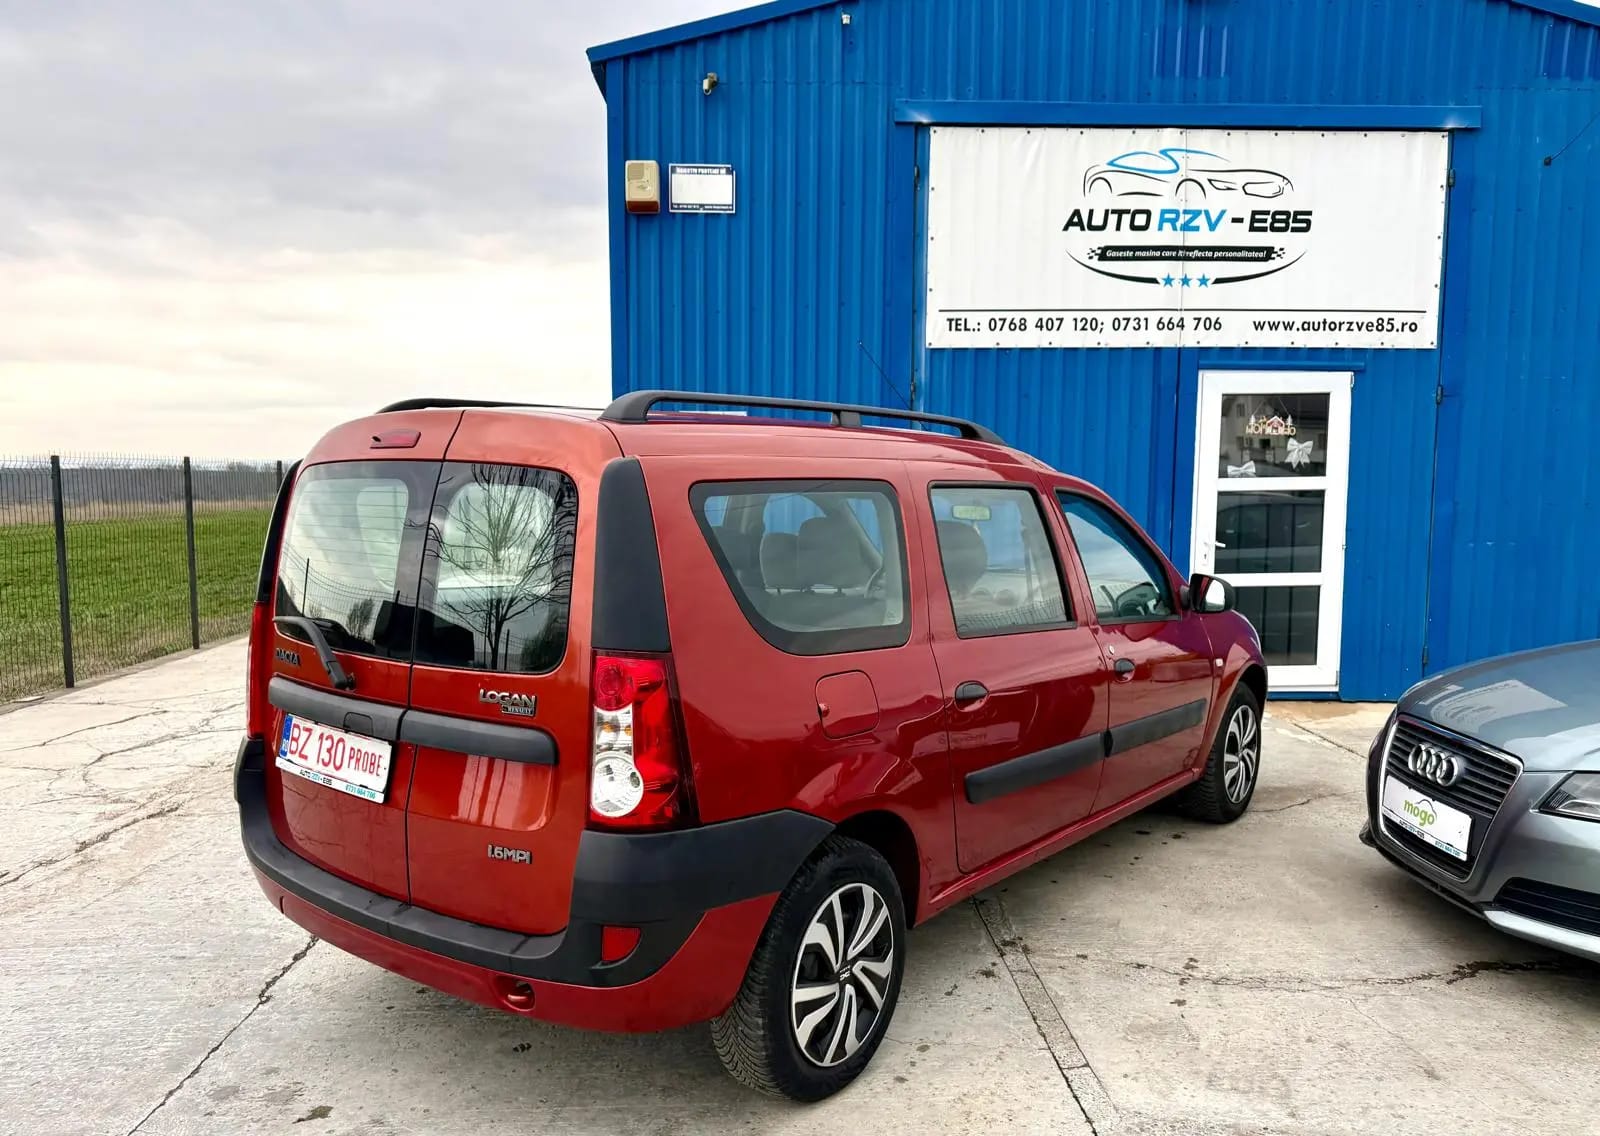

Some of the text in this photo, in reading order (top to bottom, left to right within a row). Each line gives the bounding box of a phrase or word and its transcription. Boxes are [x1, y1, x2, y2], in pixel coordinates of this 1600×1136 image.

[1062, 208, 1152, 232] AUTO
[1157, 208, 1227, 232] RZV
[1248, 209, 1312, 233] E85
[1106, 249, 1134, 258] Gaseste
[1134, 249, 1160, 258] masina
[1161, 250, 1177, 258] care
[1186, 249, 1213, 259] reflecta
[1213, 250, 1267, 259] personalitatea!
[946, 316, 1223, 334] TEL.: 0768 407 120; 0731 664 706
[1252, 317, 1419, 333] www.autorzve85.ro
[275, 648, 299, 667] DACIA
[480, 688, 536, 708] LOGAN
[289, 723, 384, 777] BZ 130 PROBE
[1403, 800, 1435, 827] mogo
[487, 845, 532, 864] 1.6MPI
